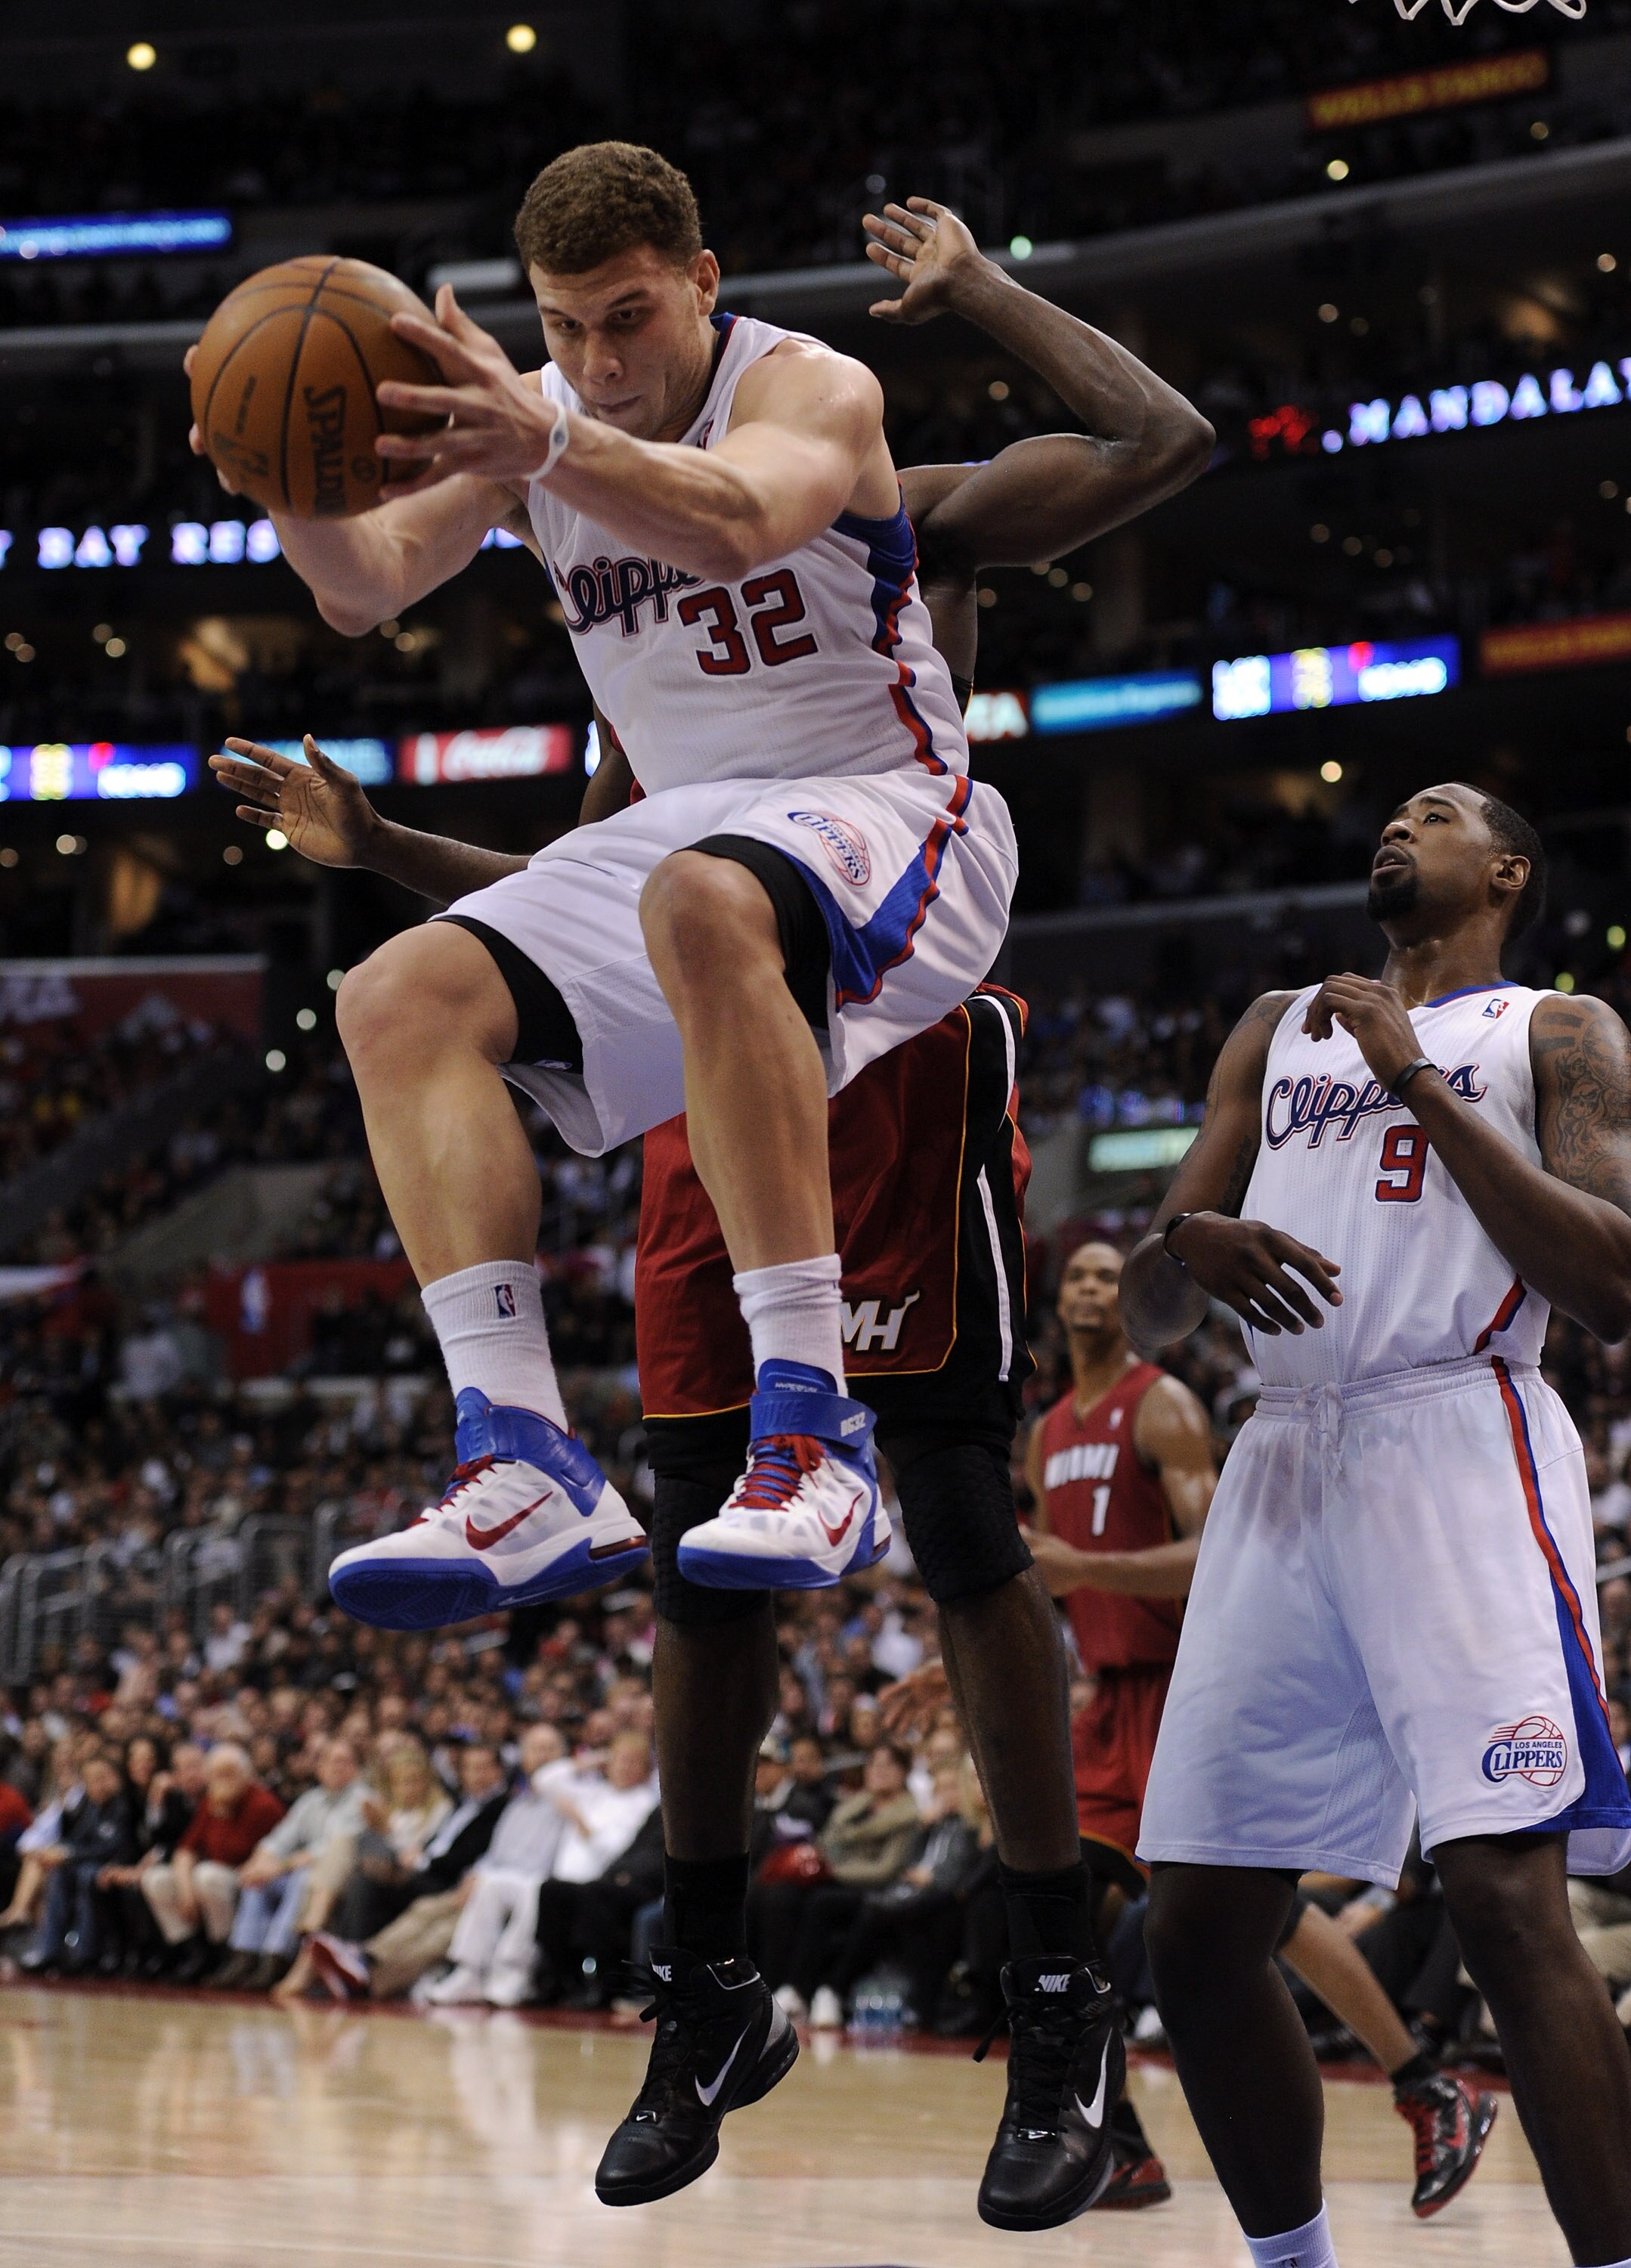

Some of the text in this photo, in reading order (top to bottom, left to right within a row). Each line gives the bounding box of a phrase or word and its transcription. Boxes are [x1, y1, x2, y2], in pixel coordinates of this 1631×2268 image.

[38, 525, 149, 569] BAY
[677, 568, 819, 676] 32
[787, 811, 860, 879] CLIPPERS
[1266, 1062, 1488, 1151] Clipps
[1375, 1124, 1430, 1203] 9
[1045, 1442, 1119, 1492] MIAMI
[1092, 1484, 1112, 1537] 1
[1481, 1741, 1563, 1783] CLIPPERS
[1515, 1741, 1530, 1749] LOS
[1034, 1974, 1071, 1993] NIKE
